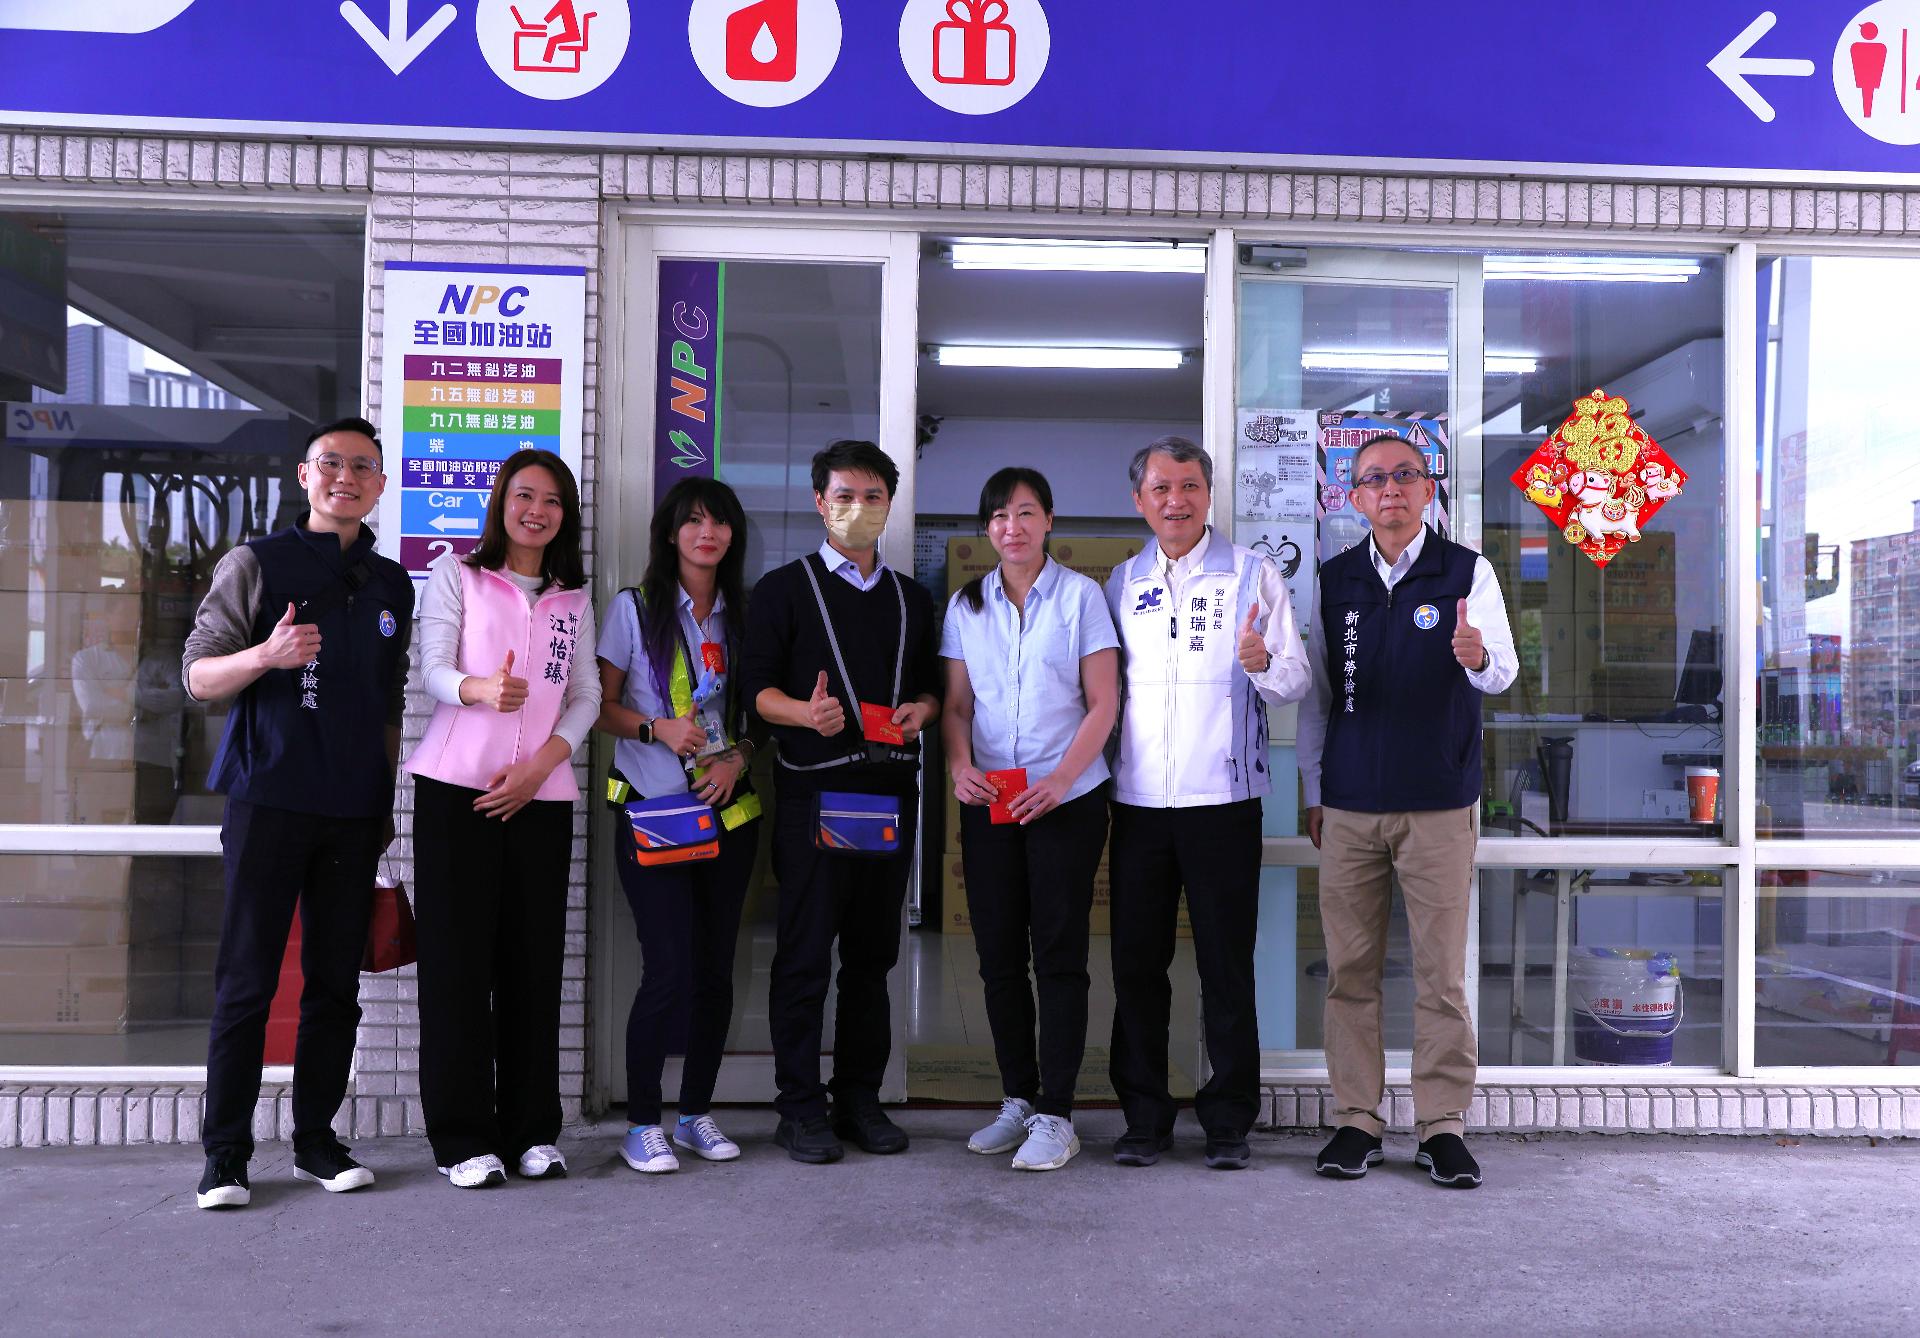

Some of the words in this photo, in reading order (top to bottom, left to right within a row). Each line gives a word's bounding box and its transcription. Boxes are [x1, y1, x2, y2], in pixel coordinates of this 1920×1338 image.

[438, 284, 529, 317] NPC
[413, 320, 552, 349] 全國加油站
[430, 361, 536, 378] 九二無鉛汽油
[671, 300, 709, 423] NPC
[430, 386, 535, 404] 九五無鉛汽油
[429, 413, 535, 430] 九八無鉛汽油
[1562, 397, 1641, 473] 福
[429, 438, 445, 453] 柴
[408, 459, 505, 473] 全國加油站股份
[428, 492, 464, 508] Car
[1189, 596, 1208, 652] 陳瑞嘉
[544, 613, 569, 685] 江怡臻
[1343, 609, 1360, 713] 新北市勞檢處
